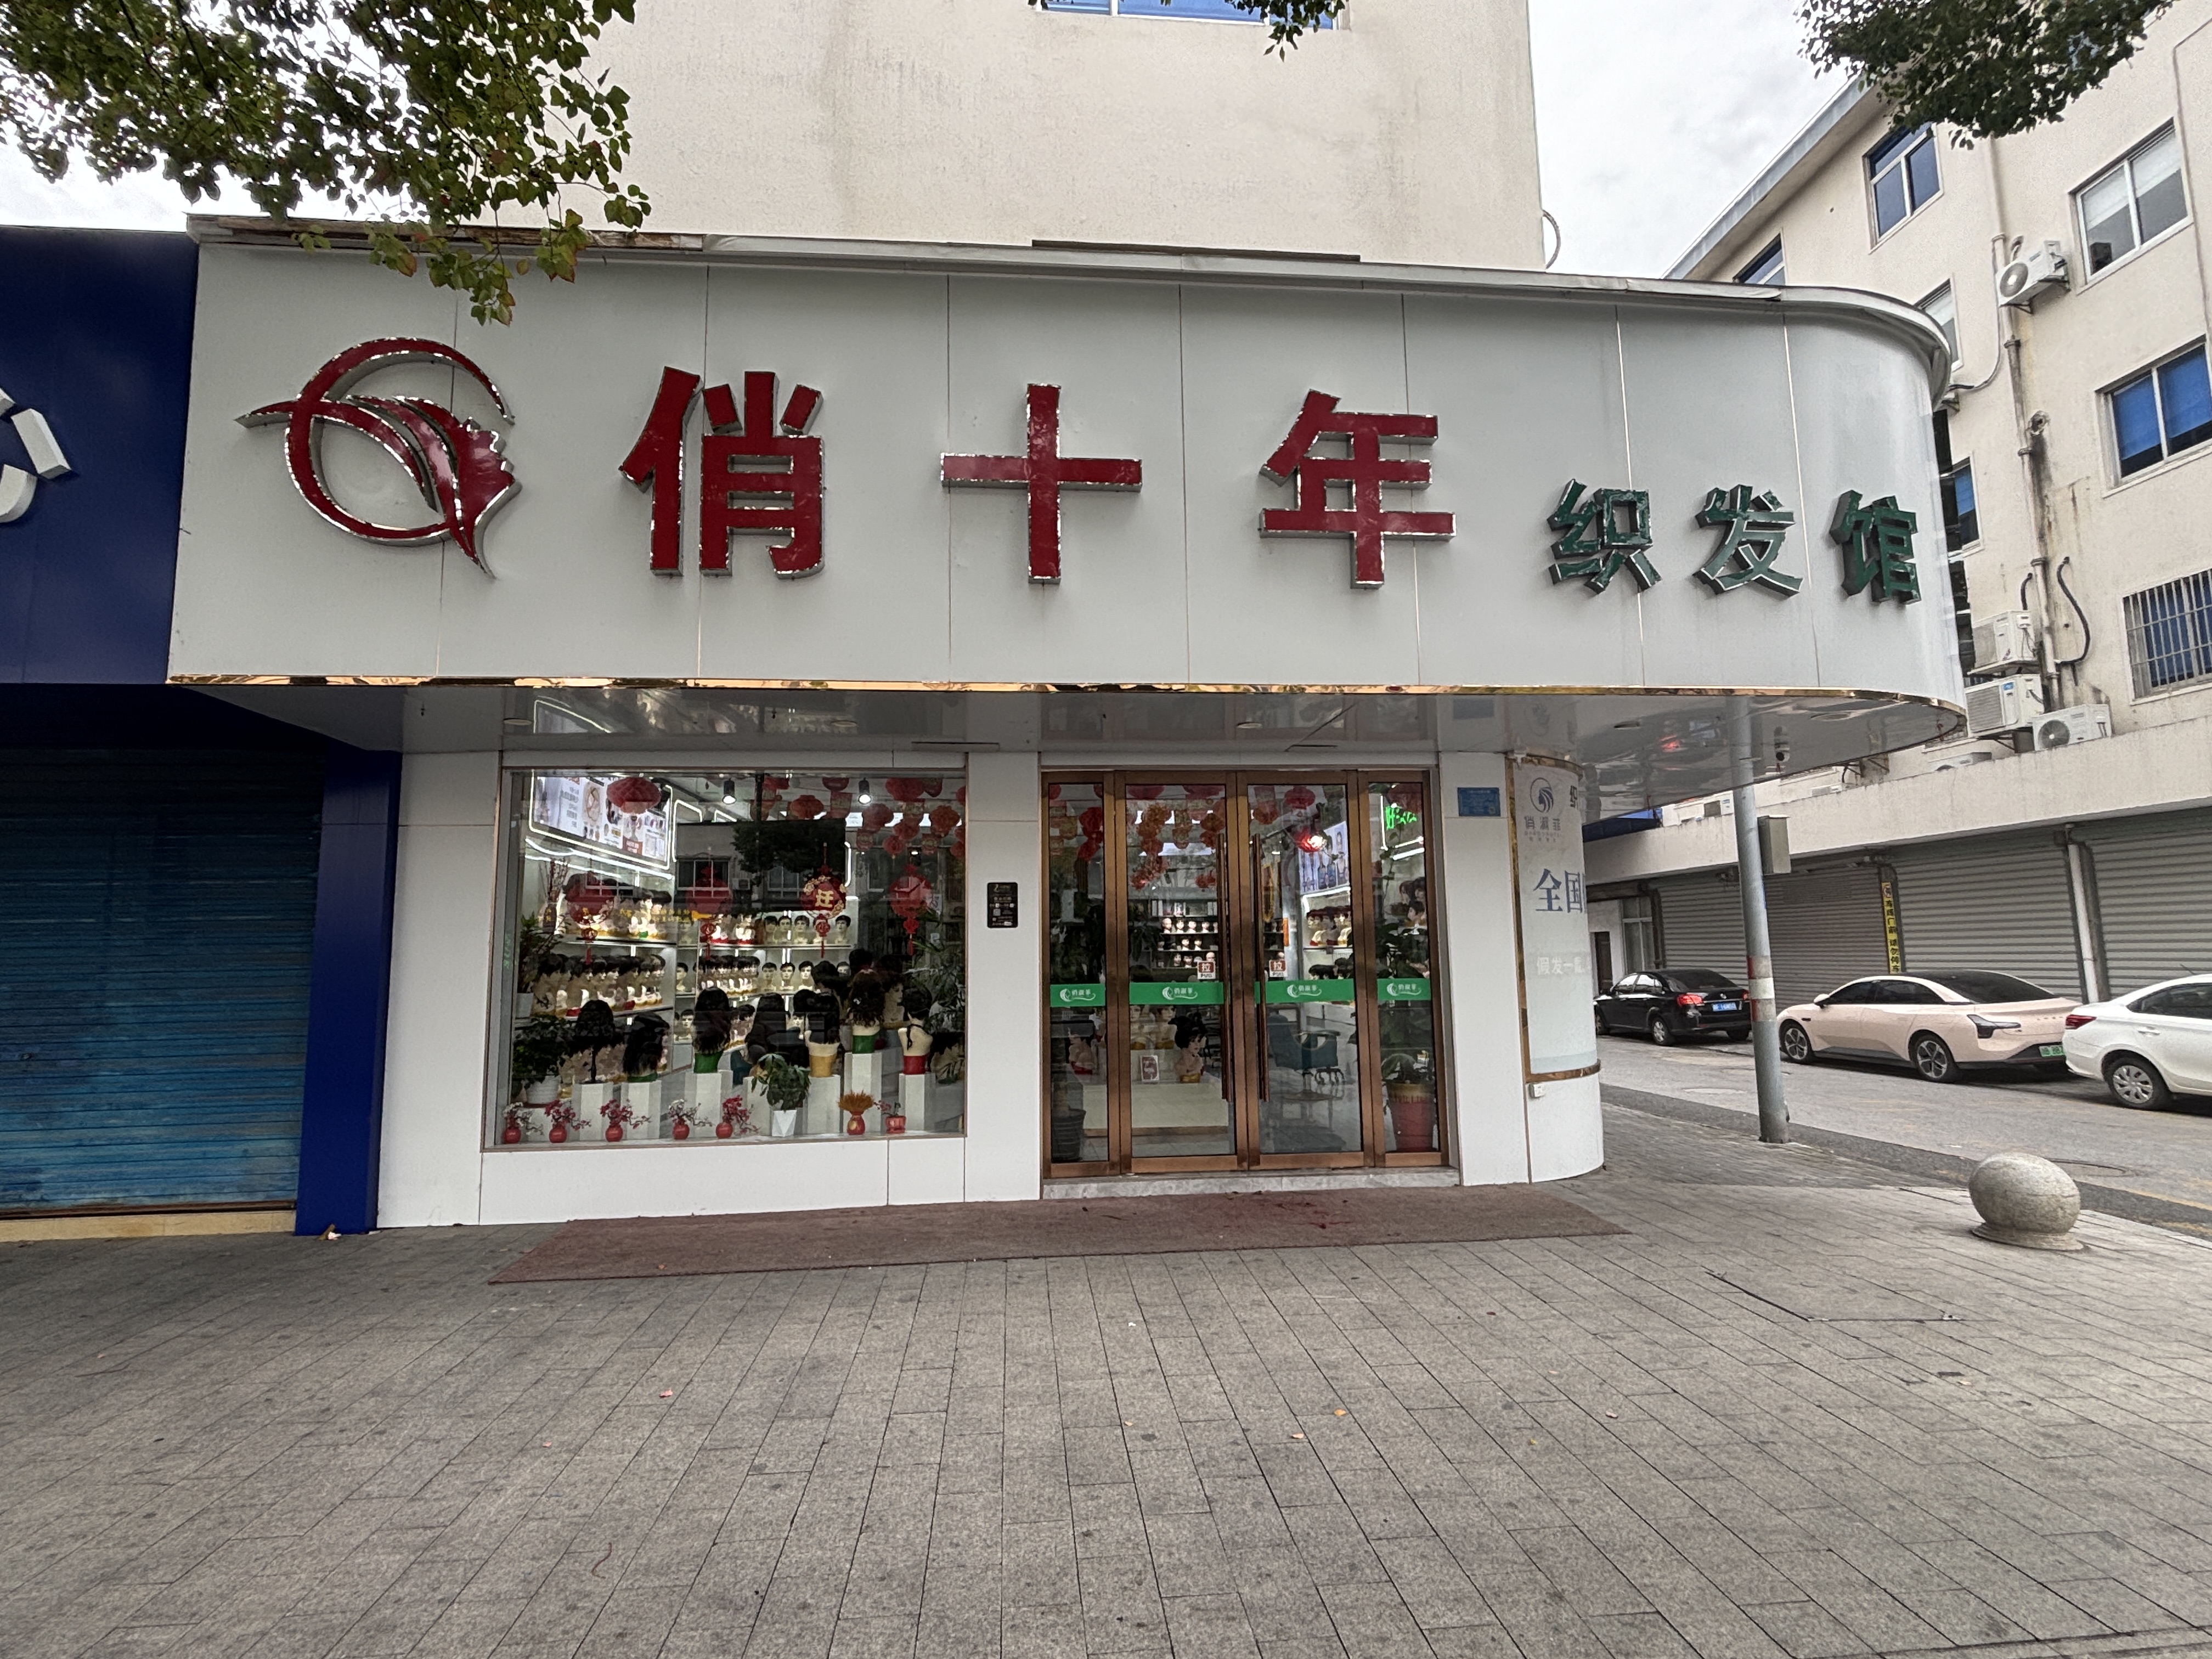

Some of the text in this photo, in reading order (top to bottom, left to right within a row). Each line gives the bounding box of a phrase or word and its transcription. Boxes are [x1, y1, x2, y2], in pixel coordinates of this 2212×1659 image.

[619, 366, 1922, 604] 俏十年 织发馆
